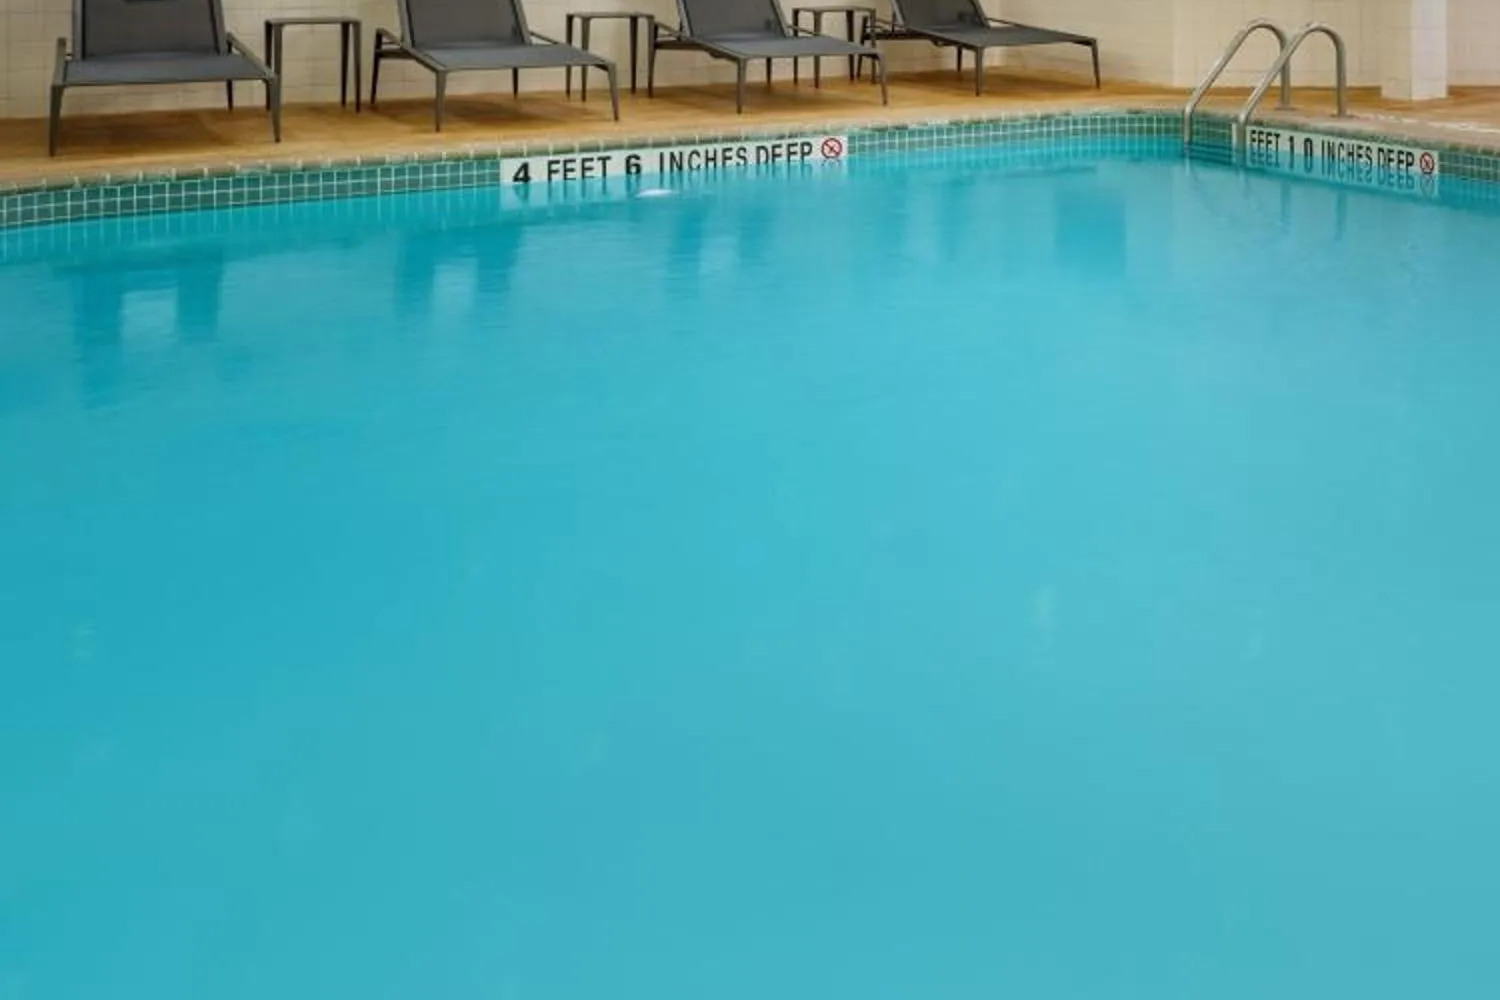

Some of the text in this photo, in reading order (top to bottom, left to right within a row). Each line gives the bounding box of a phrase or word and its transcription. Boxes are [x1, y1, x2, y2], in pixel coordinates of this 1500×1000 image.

[512, 141, 813, 183] 4 FEET 6 INCHES DEEP
[1321, 137, 1373, 167] INCHES
[1377, 146, 1415, 170] DEEP
